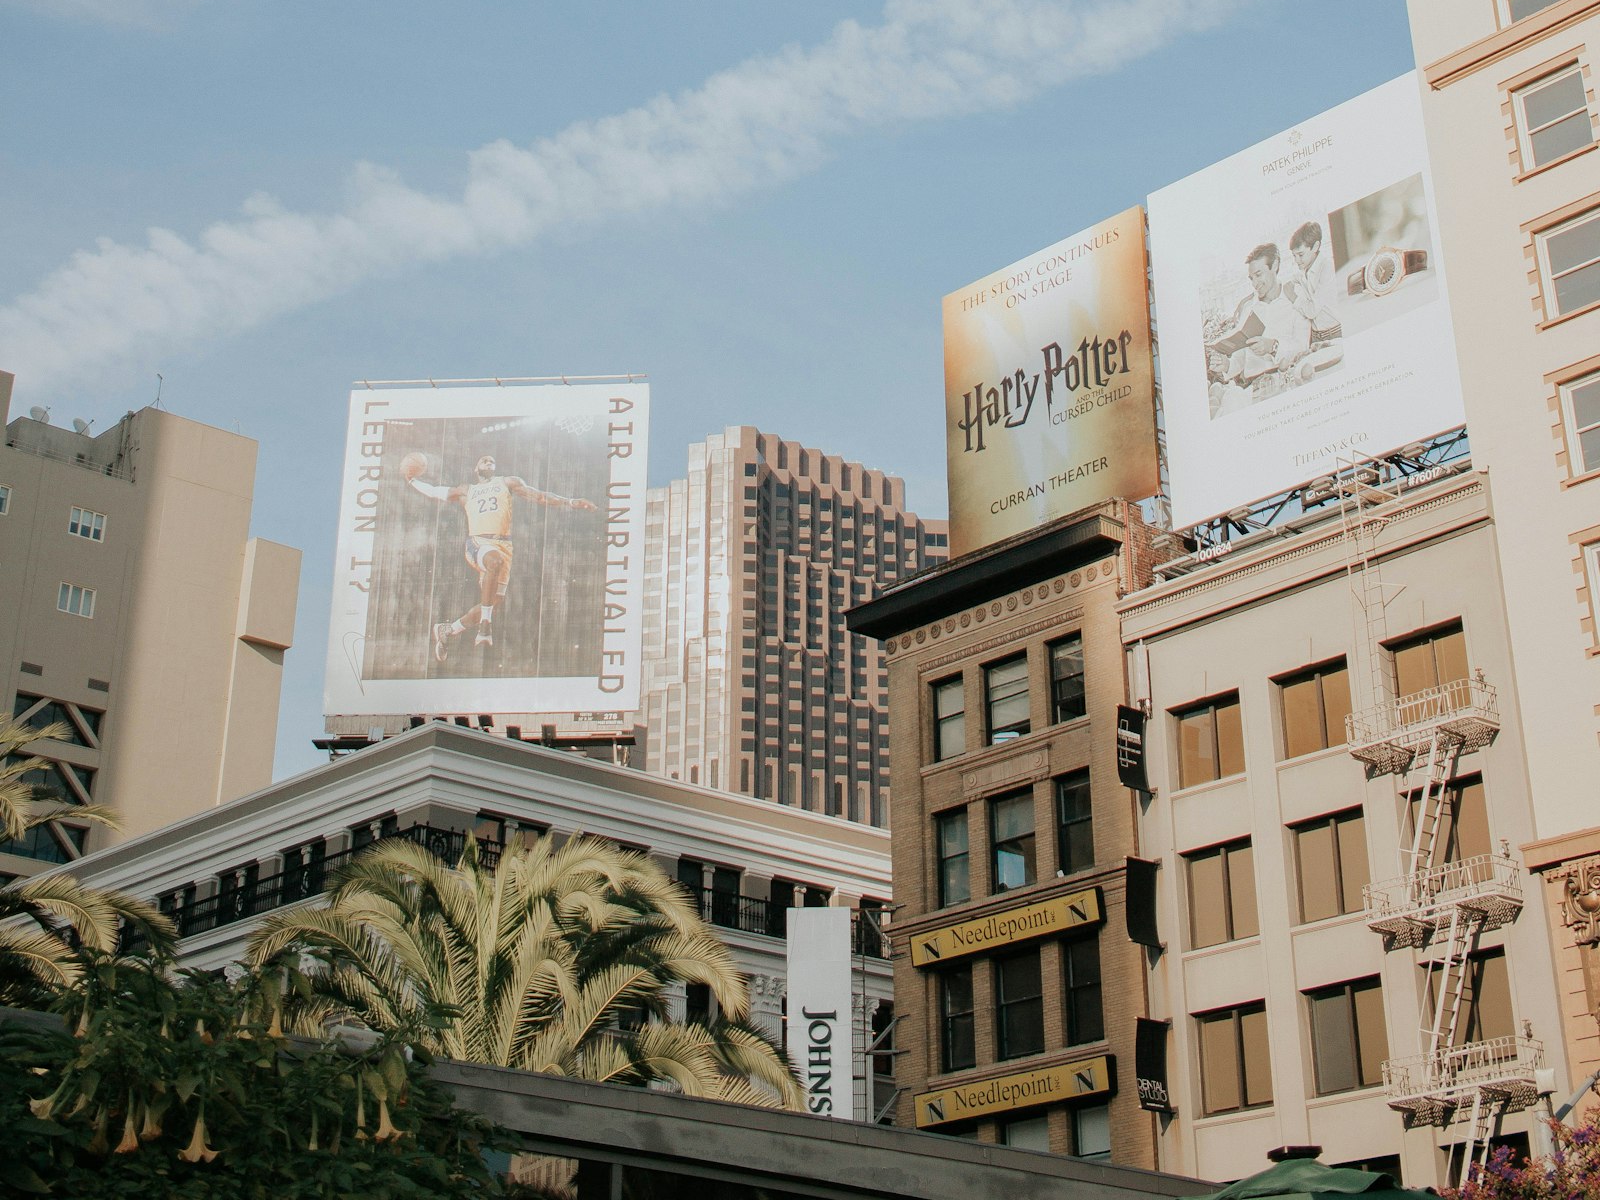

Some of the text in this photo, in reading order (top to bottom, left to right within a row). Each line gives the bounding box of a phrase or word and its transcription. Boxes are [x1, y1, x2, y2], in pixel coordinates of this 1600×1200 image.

[1262, 135, 1333, 176] PATEK PHILIPPE
[961, 227, 1120, 312] THE STORY CONTINUES
[1006, 267, 1073, 309] ON STAGE
[957, 329, 1132, 453] Harry Potter
[1052, 385, 1132, 425] CURSED CHILD
[1076, 388, 1104, 404] AND THE
[607, 397, 633, 459] AIR
[354, 401, 389, 532] LEBRON
[1292, 443, 1337, 466] TIFFANY
[478, 496, 498, 513] 23
[990, 481, 1045, 515] CURRAN
[1049, 456, 1108, 490] THEATER
[1200, 541, 1232, 560] 001624
[951, 907, 1049, 949] Needlepoint
[1067, 899, 1087, 924] N
[922, 937, 940, 961] N
[802, 1005, 837, 1117] JOHNS
[1074, 1067, 1094, 1093] N
[953, 1073, 1053, 1111] Needlepoint
[1137, 1078, 1165, 1092] DENTAL
[1139, 1090, 1168, 1102] STUDIO
[927, 1098, 944, 1123] N
